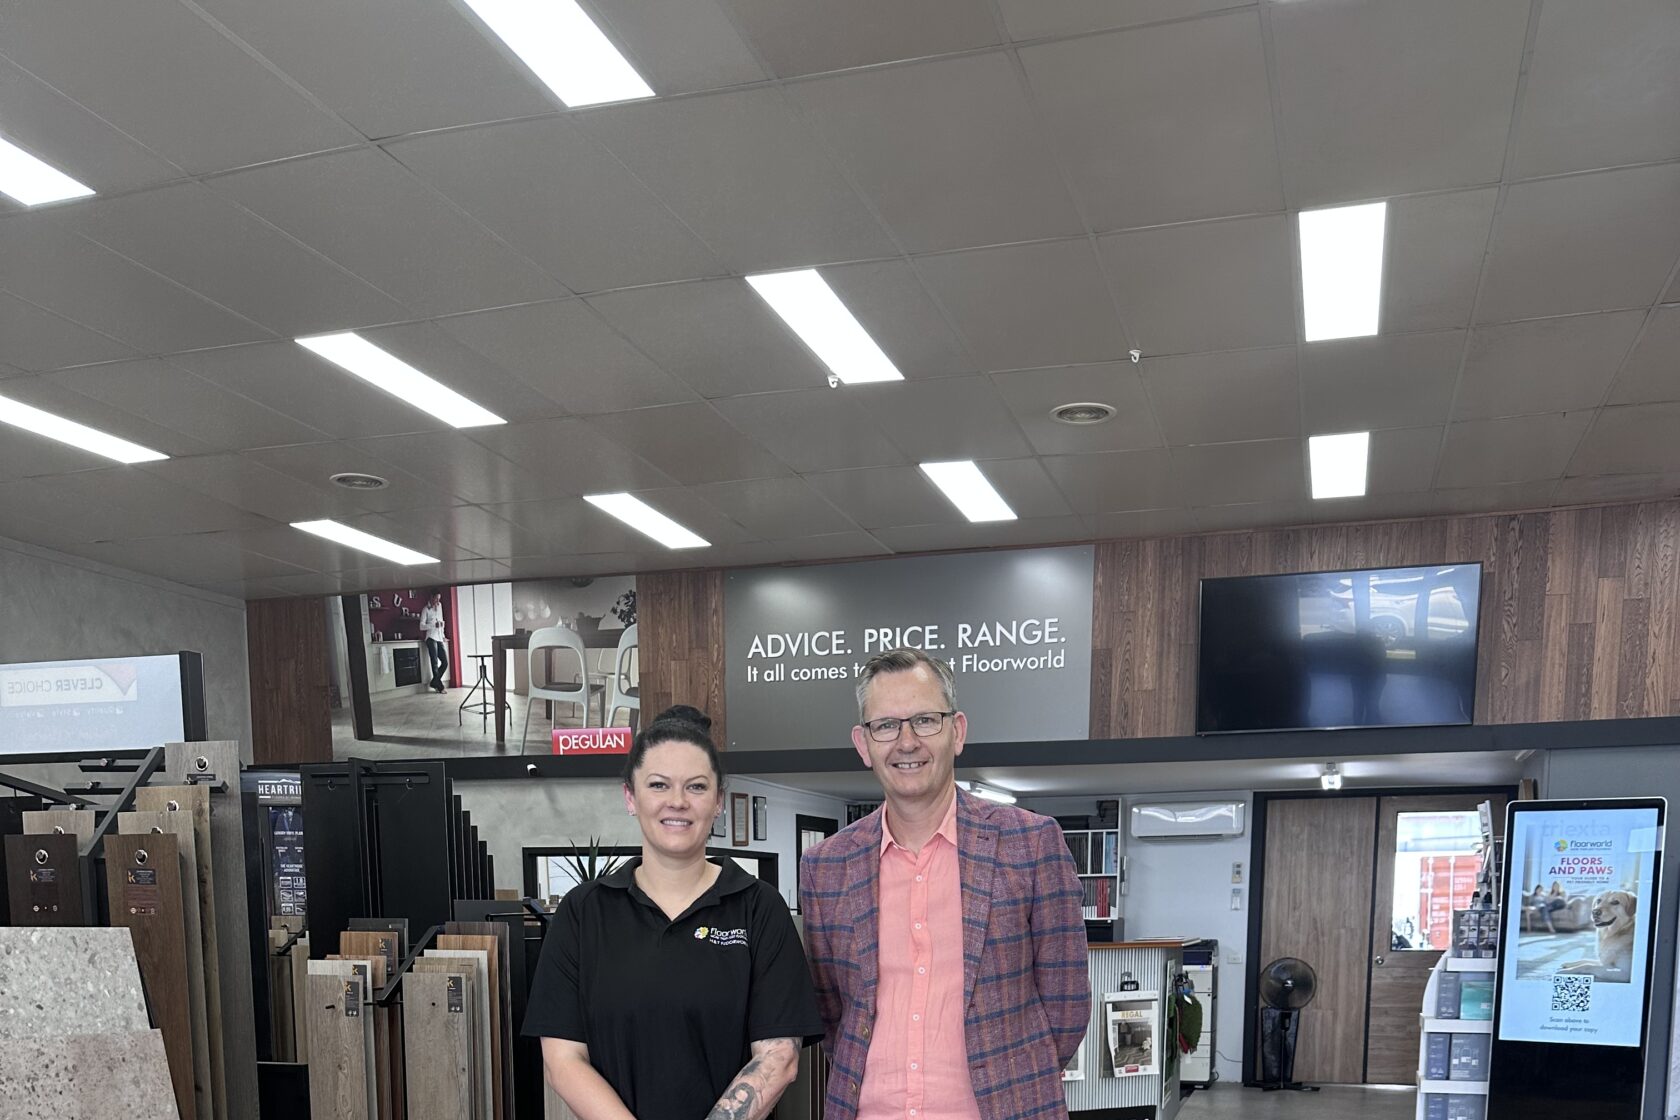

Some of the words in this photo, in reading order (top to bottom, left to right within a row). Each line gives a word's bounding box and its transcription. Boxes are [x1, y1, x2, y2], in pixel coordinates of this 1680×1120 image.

[747, 630, 852, 659] ADVICE.
[864, 625, 946, 653] PRICE.
[957, 617, 1067, 648] RANGE.
[747, 665, 759, 682] It
[764, 663, 785, 682] all
[790, 665, 848, 681] comes
[962, 649, 1065, 673] Floorworld
[1570, 840, 1613, 848] floorworld
[1560, 857, 1603, 865] FLOORS
[1549, 866, 1575, 875] AND
[1580, 866, 1613, 875] PAWS
